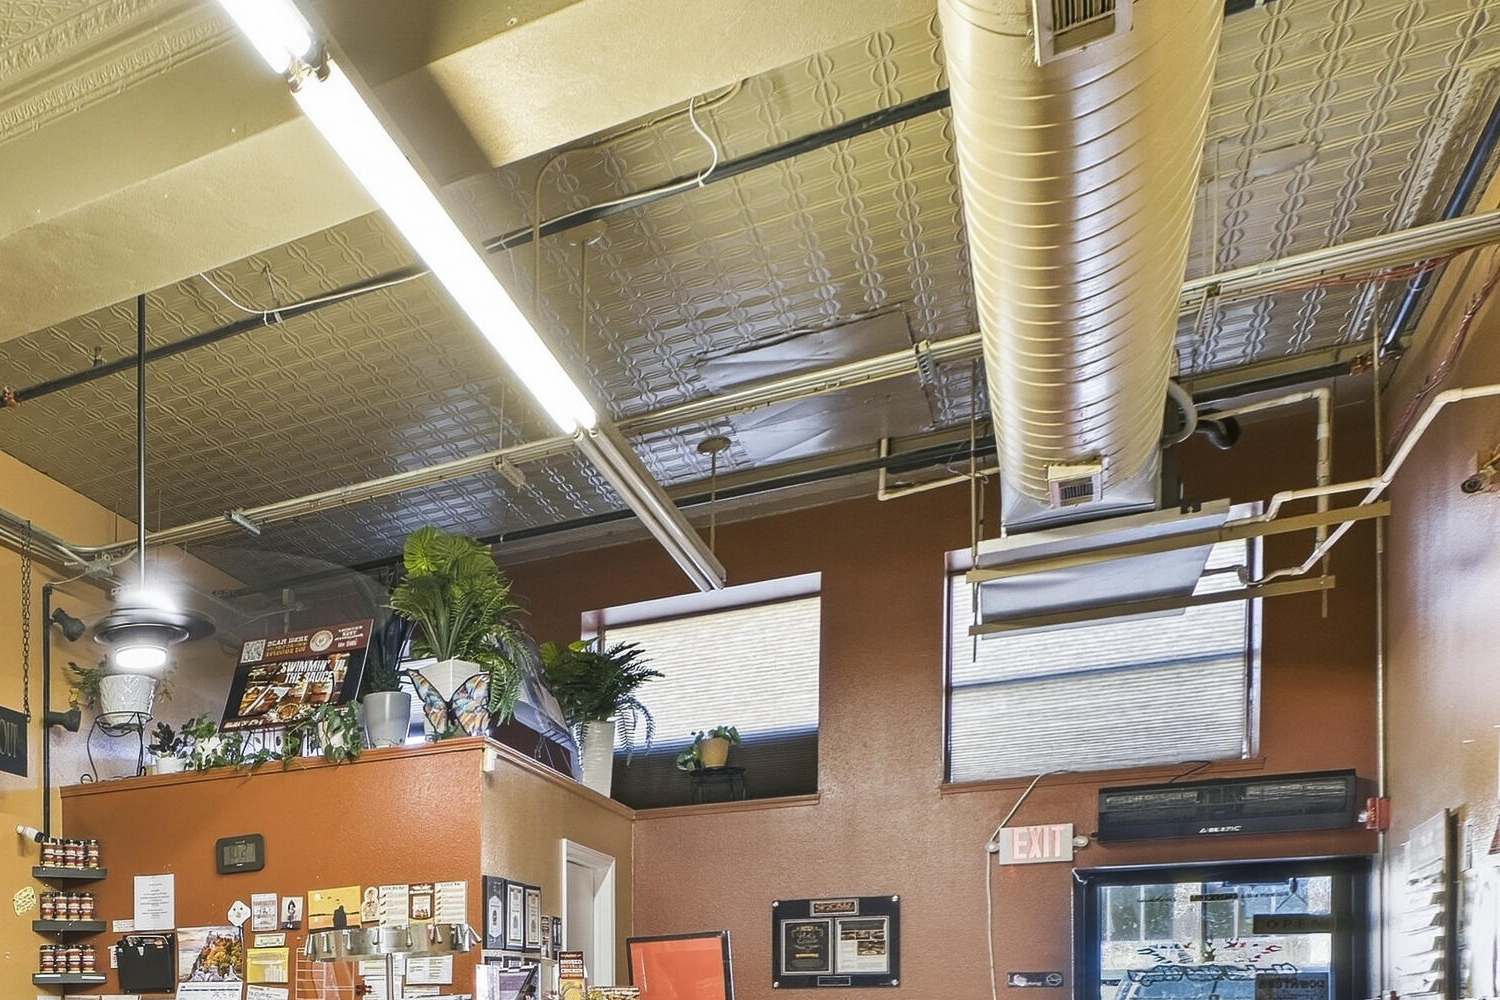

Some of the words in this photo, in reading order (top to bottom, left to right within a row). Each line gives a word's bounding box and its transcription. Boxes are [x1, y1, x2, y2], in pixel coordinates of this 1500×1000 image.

[284, 672, 304, 684] THE
[304, 671, 335, 683] SAUCE
[1013, 825, 1065, 860] EXIT
[1264, 918, 1323, 929] OPEN
